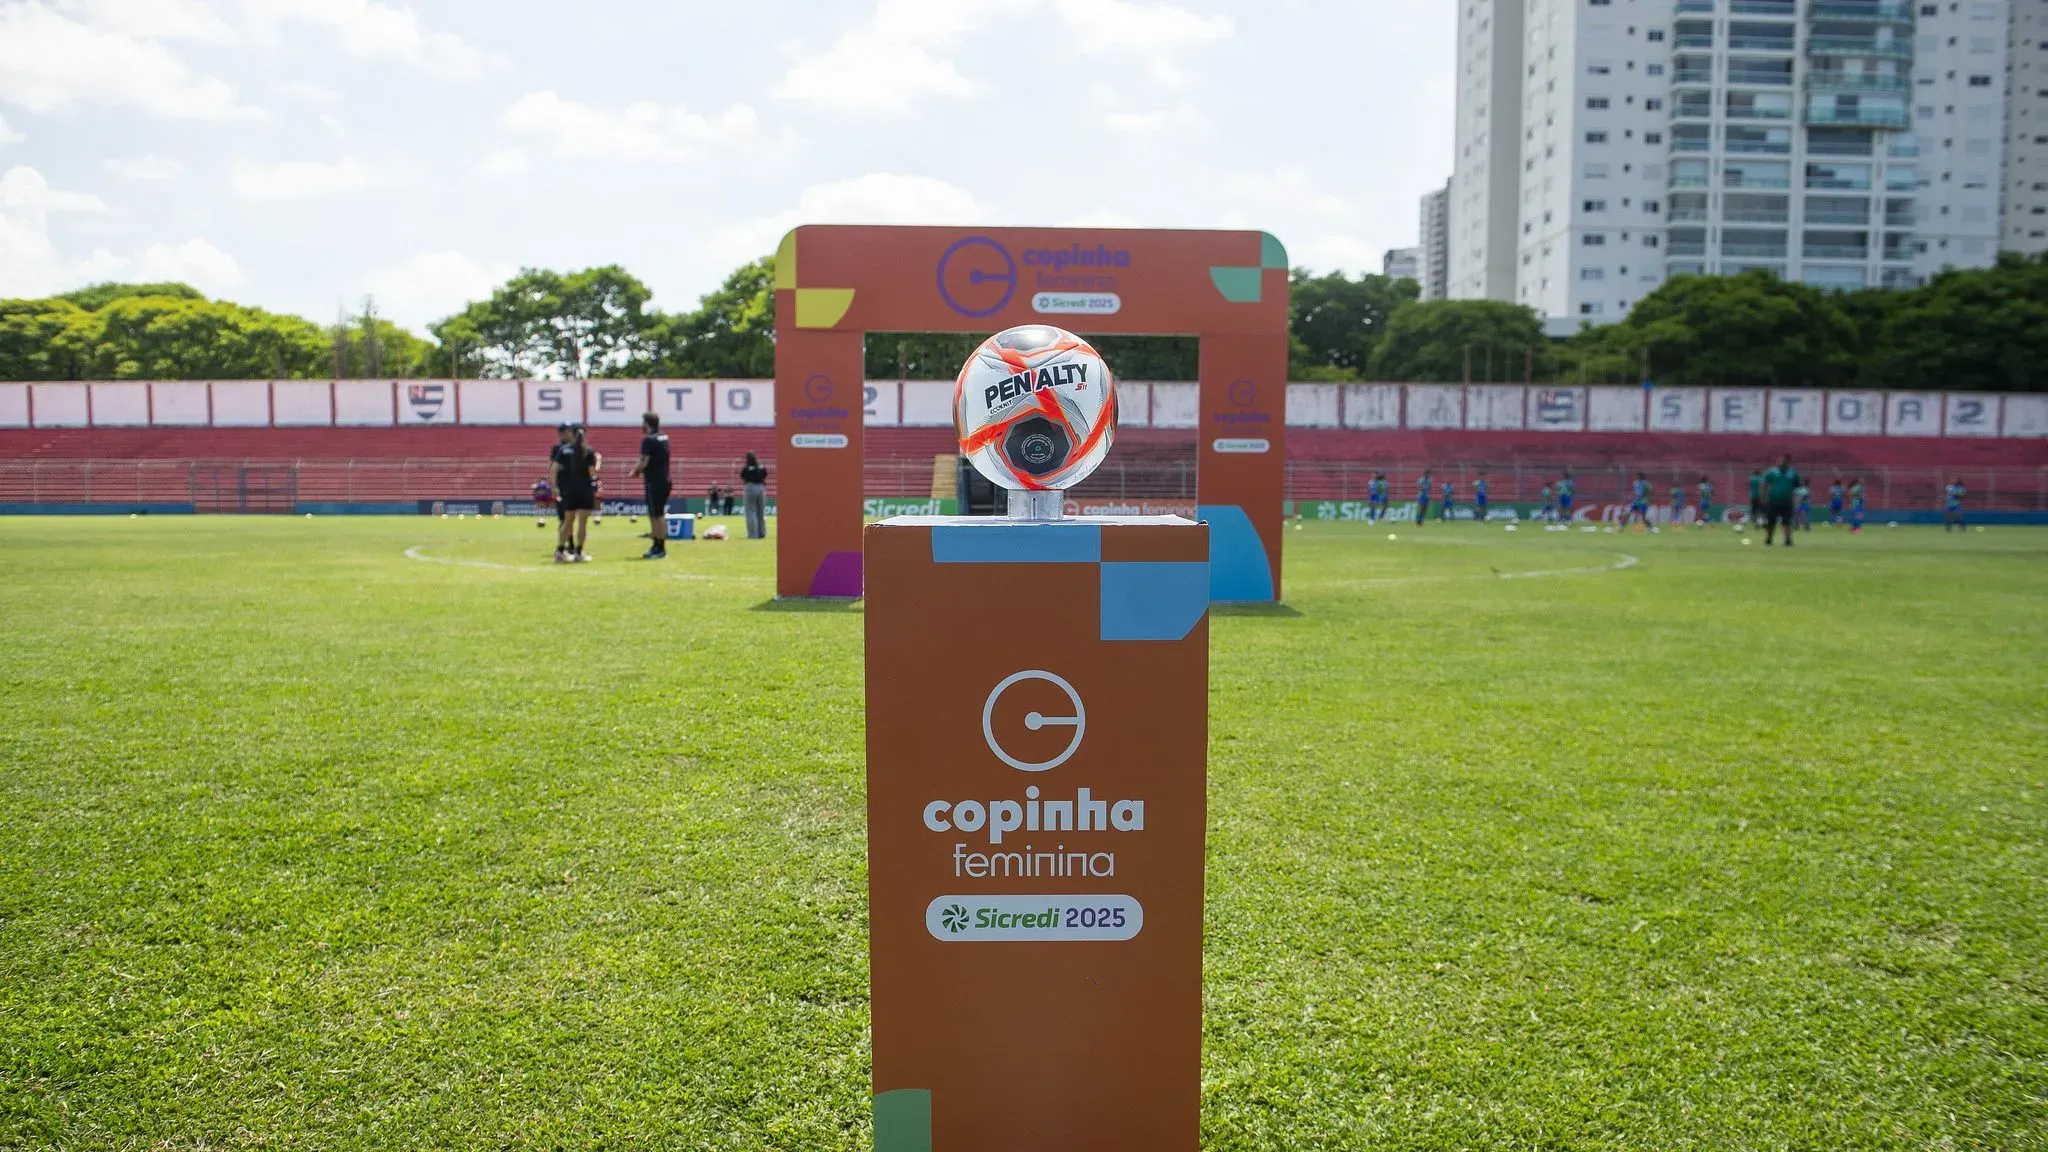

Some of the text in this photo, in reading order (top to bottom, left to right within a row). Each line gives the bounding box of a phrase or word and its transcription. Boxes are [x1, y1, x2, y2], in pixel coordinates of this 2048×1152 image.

[1023, 241, 1130, 271] copinha
[1052, 298, 1114, 309] Sicredi 2025
[984, 363, 1088, 410] PENALTY
[864, 500, 941, 517] Sicredi
[923, 785, 1144, 844] copinha
[953, 843, 1115, 878] feminina
[975, 907, 1126, 929] Sicredi 2025
